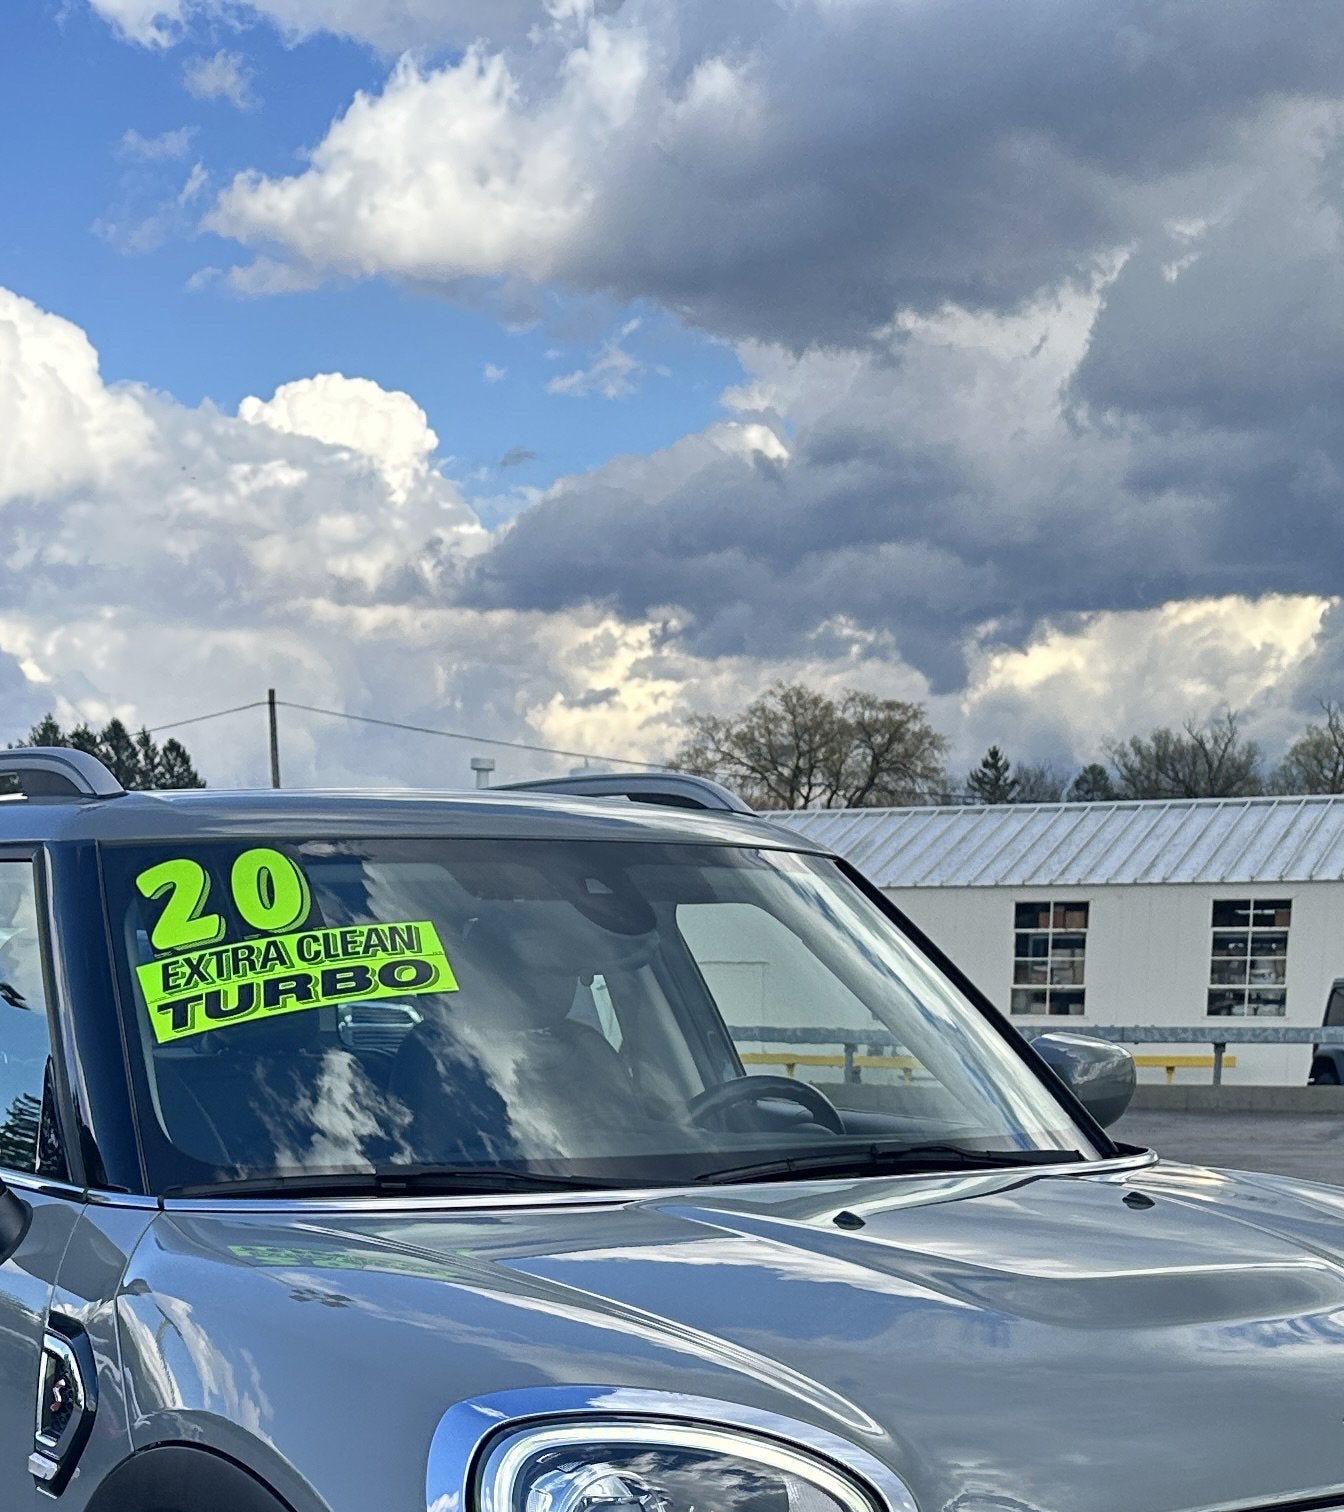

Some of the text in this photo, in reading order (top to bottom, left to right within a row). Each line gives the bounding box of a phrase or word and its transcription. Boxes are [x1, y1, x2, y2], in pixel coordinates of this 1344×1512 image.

[136, 848, 311, 951] 20
[157, 958, 439, 1032] TURBO
[162, 924, 422, 997] EXTRA CLEAN
